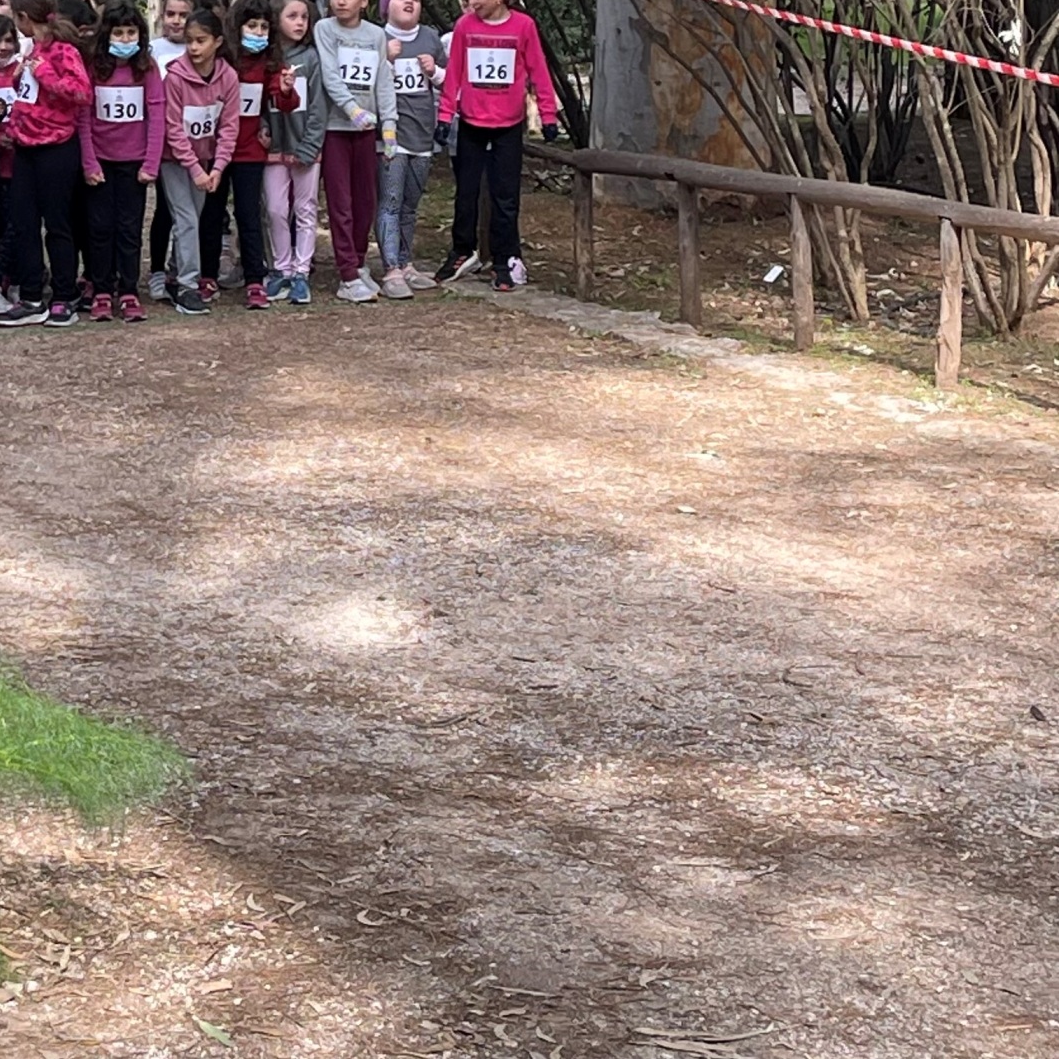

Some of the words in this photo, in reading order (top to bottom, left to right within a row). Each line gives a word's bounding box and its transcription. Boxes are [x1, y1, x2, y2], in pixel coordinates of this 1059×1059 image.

[340, 64, 372, 82] 125
[475, 64, 507, 80] 126
[393, 74, 424, 90] 502
[103, 103, 137, 119] 130
[190, 120, 213, 136] 08
